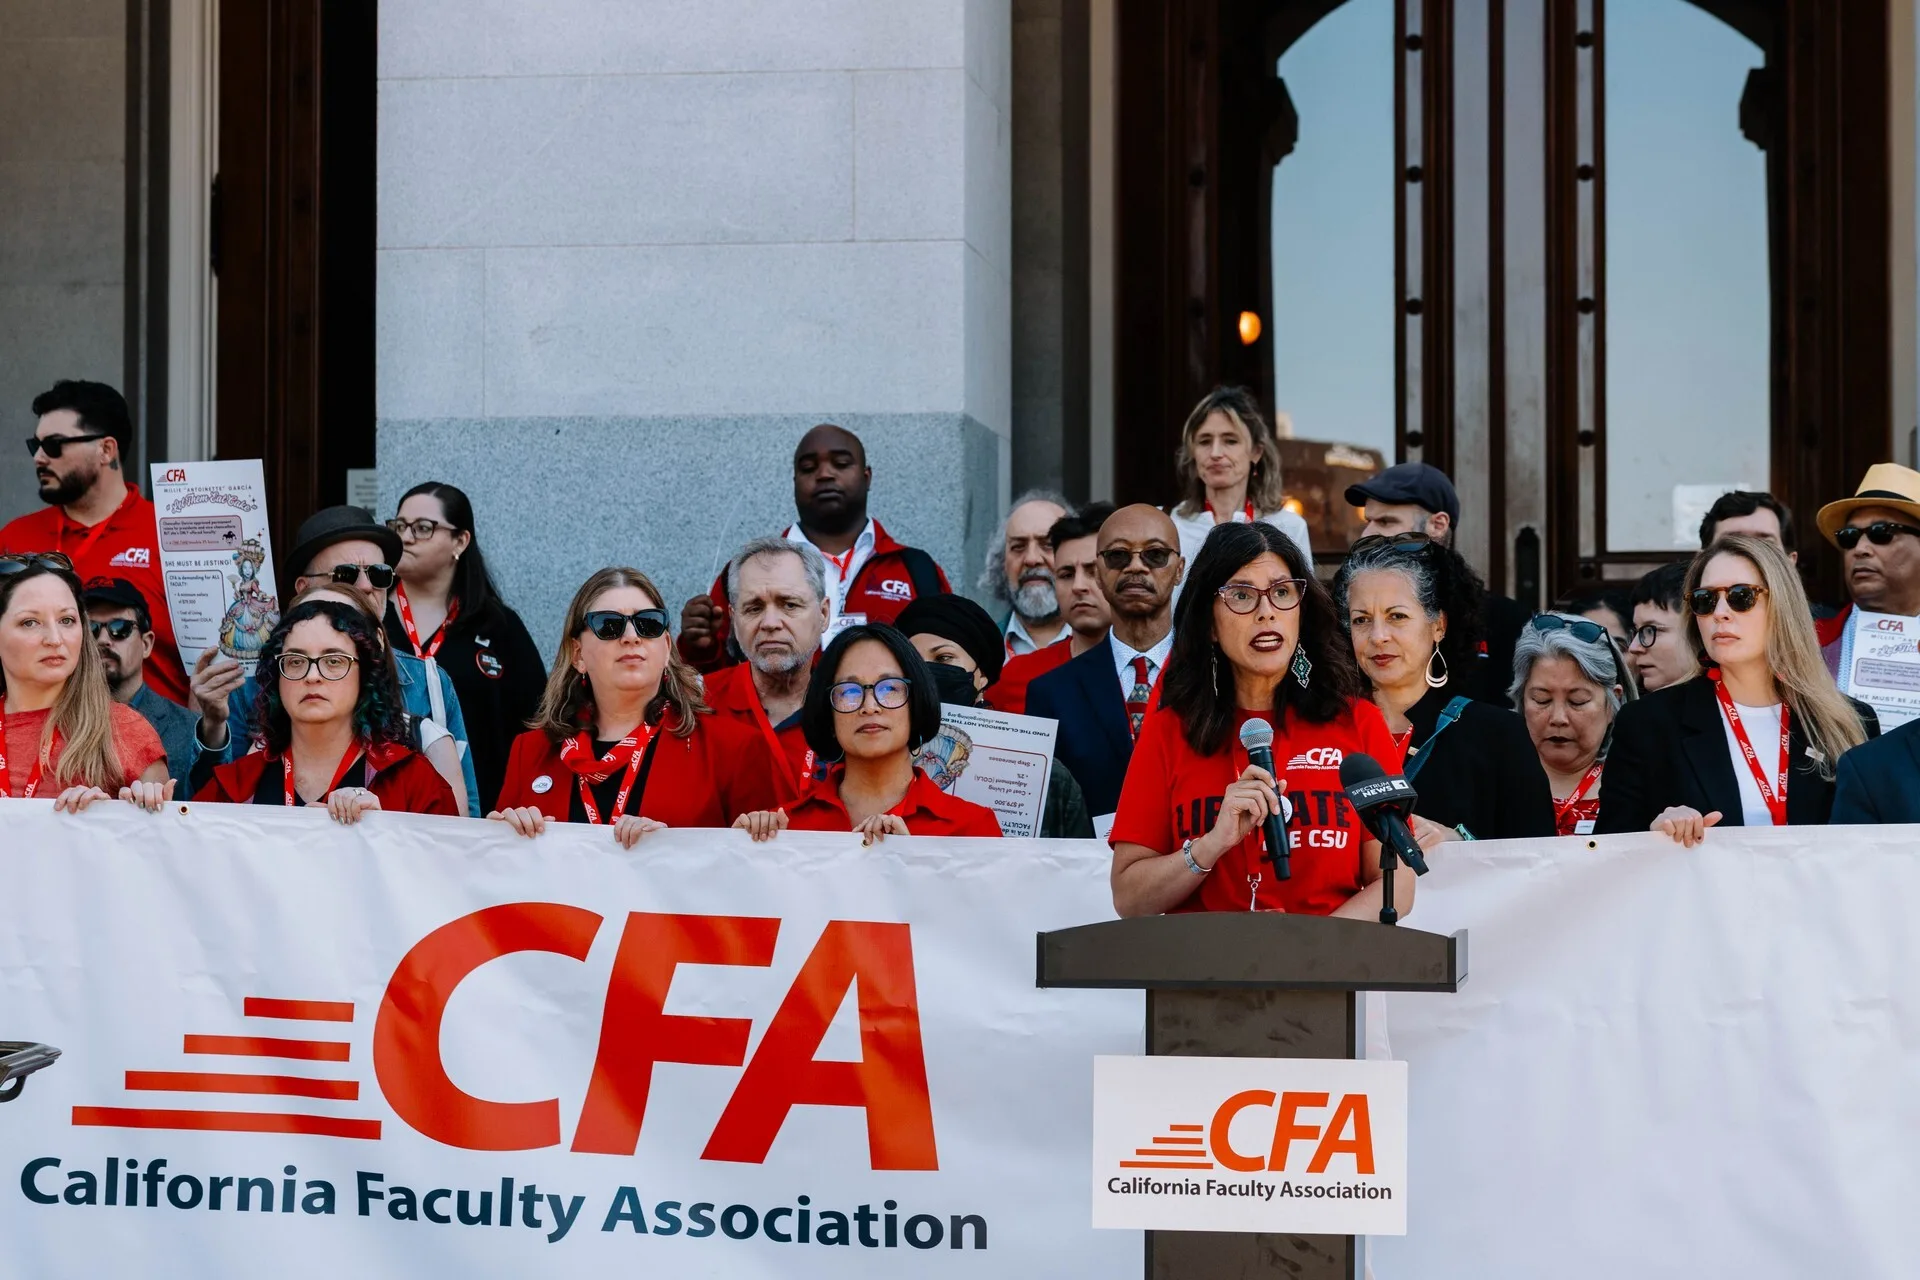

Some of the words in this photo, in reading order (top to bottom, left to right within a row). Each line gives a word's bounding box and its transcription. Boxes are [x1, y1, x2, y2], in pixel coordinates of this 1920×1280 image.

[166, 469, 186, 482] CFA
[125, 547, 150, 563] CFA
[203, 559, 232, 567] JESTING!
[881, 580, 912, 597] CFA
[839, 618, 856, 627] CFA
[1877, 619, 1904, 632] CFA
[978, 723, 1019, 733] CLASSROOM
[988, 756, 1017, 765] increases
[1305, 747, 1343, 765] CFA
[974, 775, 995, 784] (COLA)
[995, 778, 1027, 788] Adjustment
[988, 784, 1005, 793] Living
[1351, 781, 1390, 796] SPECTRUM
[1362, 785, 1393, 798] NEWS
[994, 800, 1018, 808] $79,500
[1175, 790, 1351, 838] LIBATE
[1001, 821, 1031, 830] FACULTY:
[1308, 829, 1349, 850] CSU
[372, 901, 939, 1171] CFA
[1209, 1089, 1376, 1175] CFA
[1107, 1177, 1201, 1196] California
[1206, 1179, 1276, 1202] Faculty
[1280, 1181, 1392, 1200] Association
[20, 1156, 336, 1215] California
[357, 1169, 585, 1244] Faculty
[601, 1186, 988, 1251] Association
